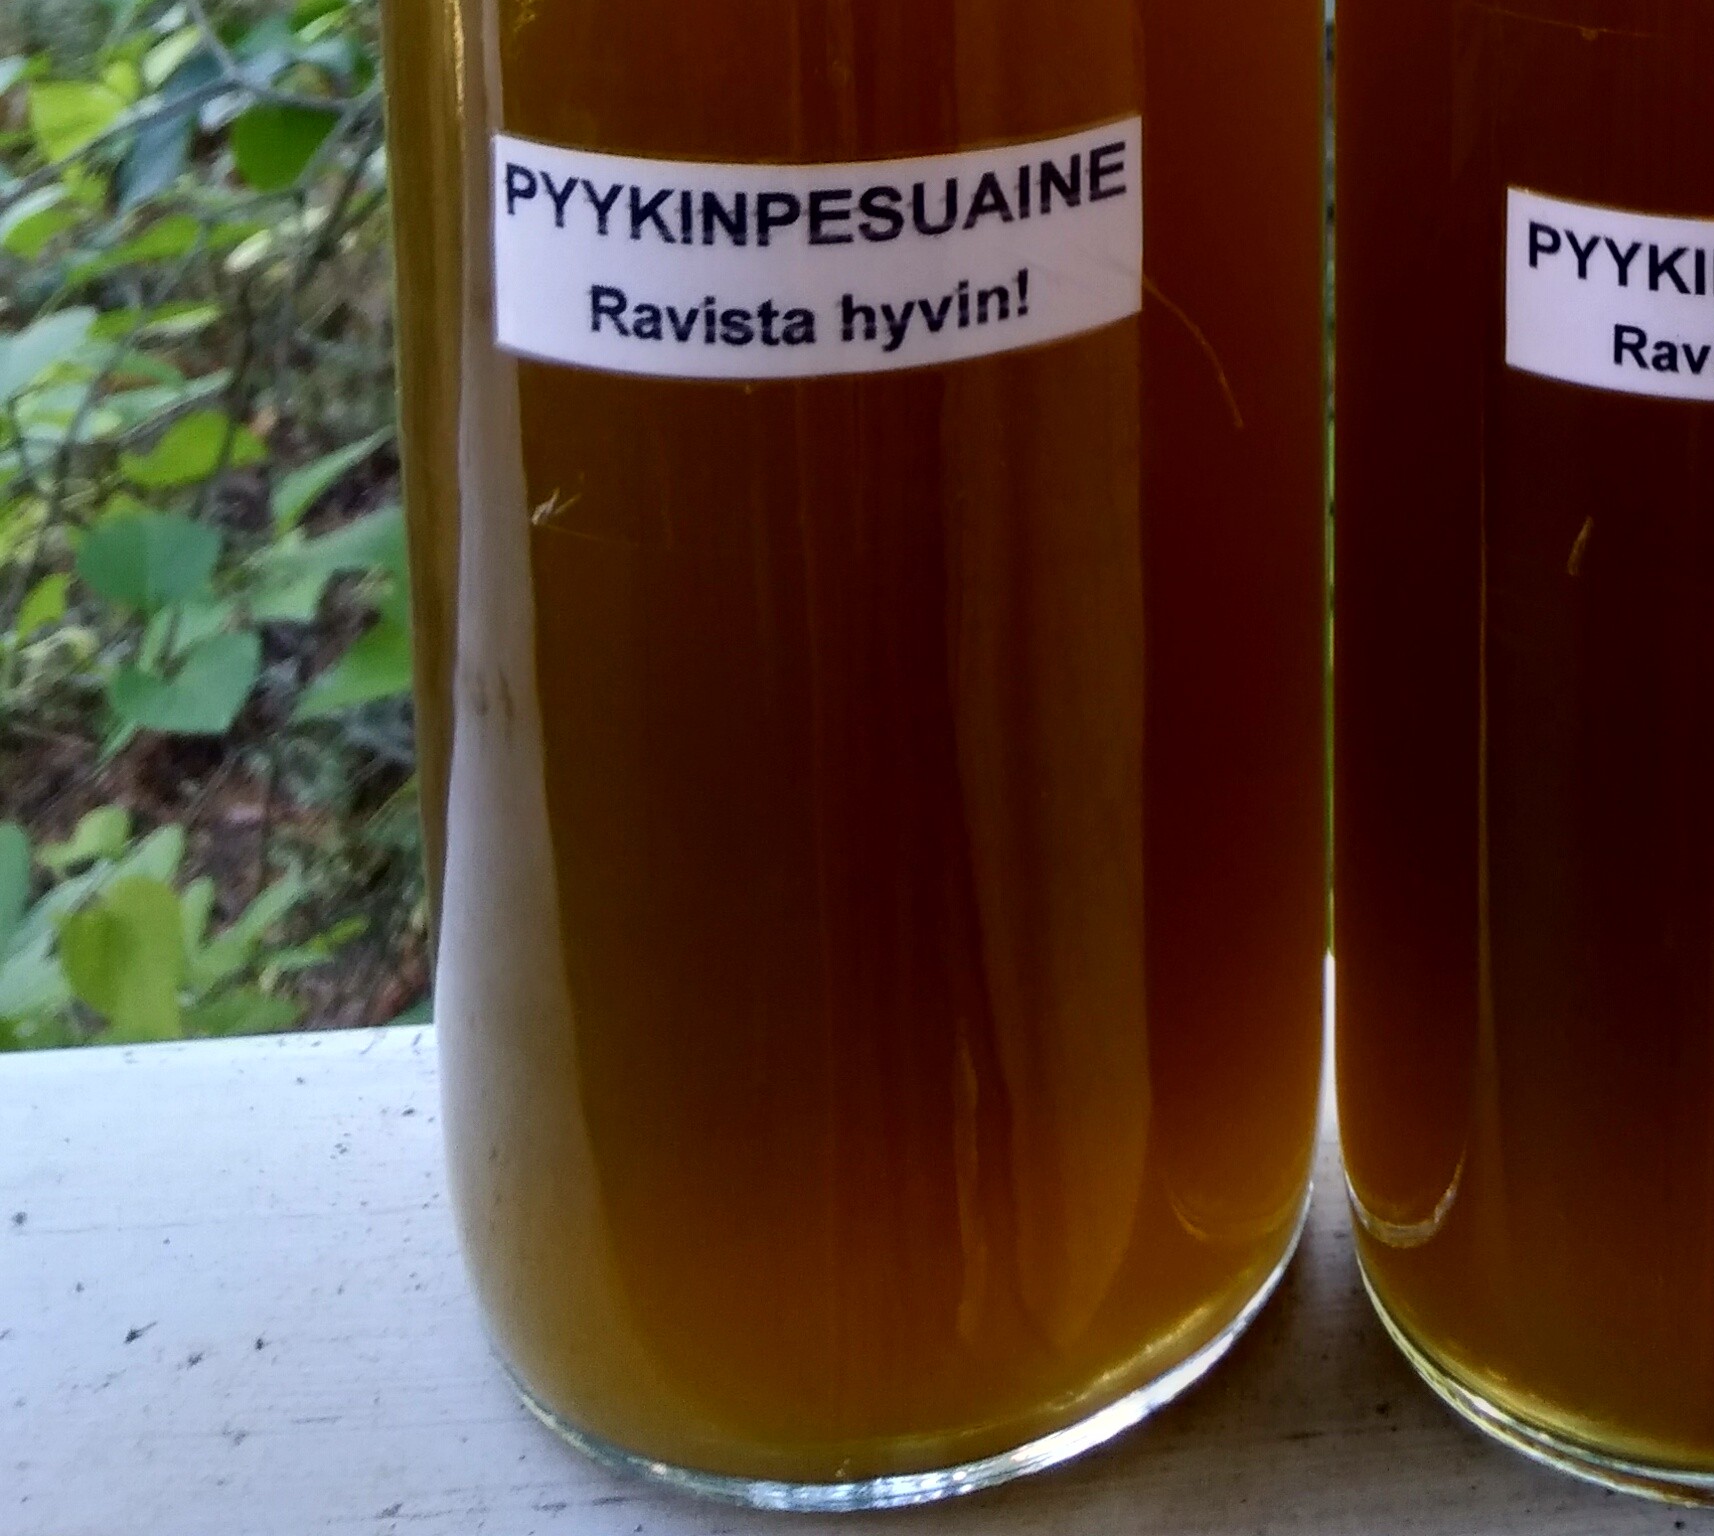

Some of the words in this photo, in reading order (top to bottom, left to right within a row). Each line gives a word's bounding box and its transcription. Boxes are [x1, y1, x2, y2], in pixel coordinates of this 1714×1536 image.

[505, 140, 1127, 247] PYYKINPESUAINE
[589, 284, 816, 346] Ravista
[840, 268, 1030, 352] hyvin!
